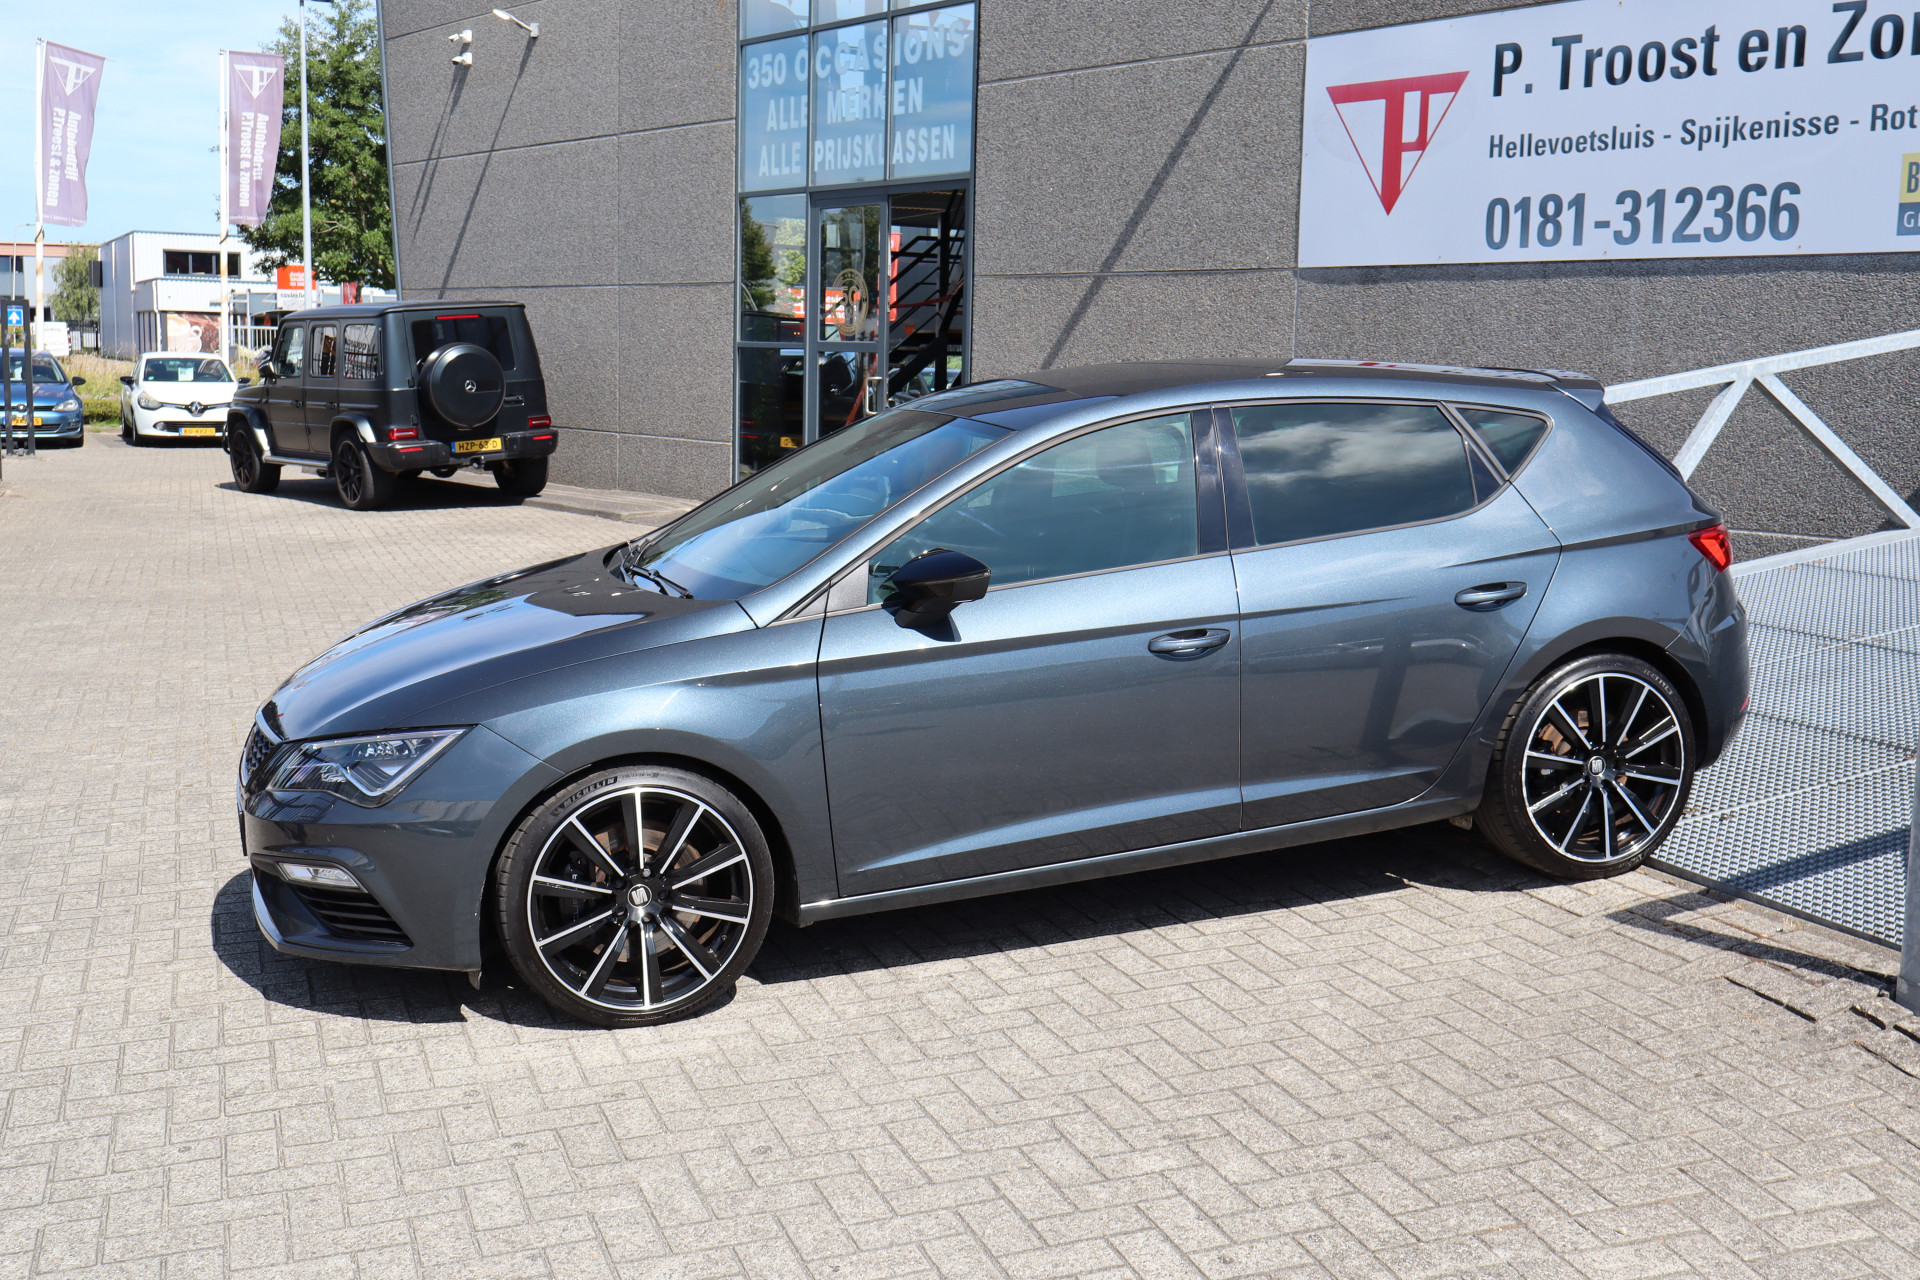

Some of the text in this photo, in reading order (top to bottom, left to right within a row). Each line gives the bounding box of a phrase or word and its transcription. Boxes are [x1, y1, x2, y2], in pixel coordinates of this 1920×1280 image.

[748, 20, 966, 90] 350 OCCASIONS
[1492, 42, 1533, 97] P.
[1551, 24, 1720, 91] Troost
[1737, 24, 1807, 73] en
[766, 77, 924, 132] ALLE MERKEN
[758, 124, 955, 177] ALLE PRIJSKLASSEN
[1488, 123, 1655, 159] Hellevoetsluis
[1680, 112, 1840, 151] Spijkenisse
[49, 157, 62, 167] &
[240, 160, 251, 170] &
[1485, 181, 1801, 250] 0181-312366
[458, 440, 498, 451] HZP-63-D
[563, 777, 616, 806] MICHELIN
